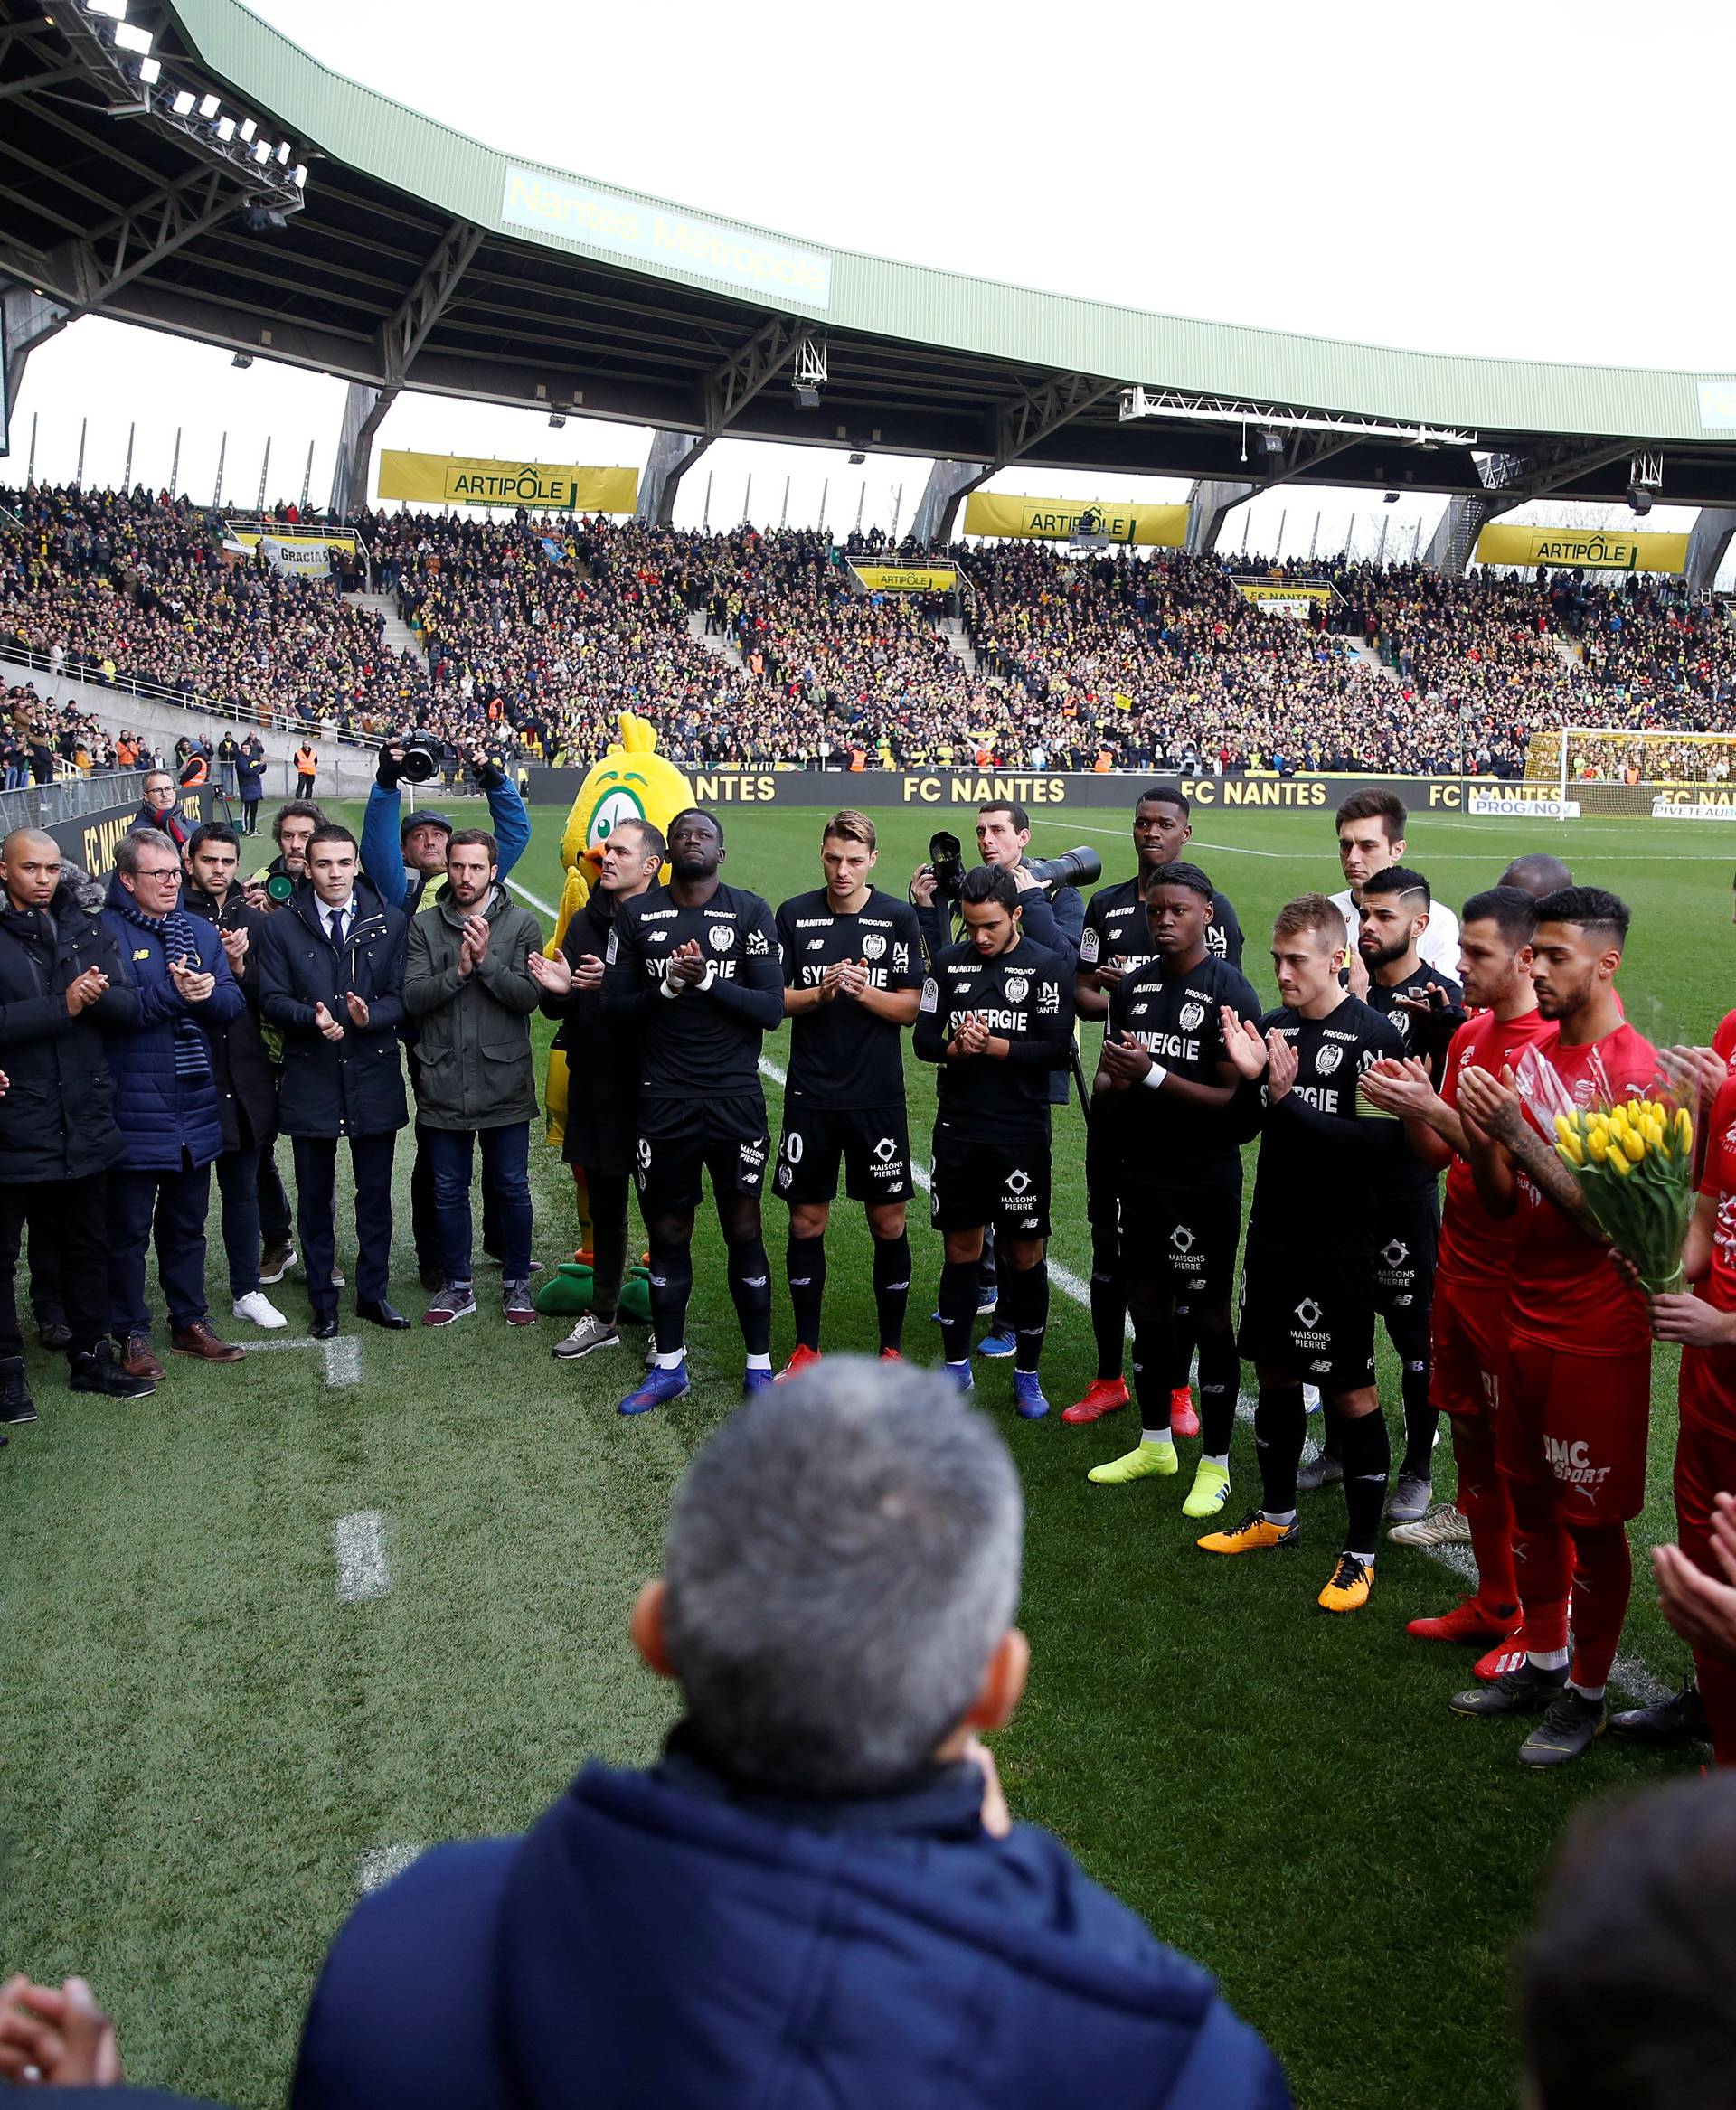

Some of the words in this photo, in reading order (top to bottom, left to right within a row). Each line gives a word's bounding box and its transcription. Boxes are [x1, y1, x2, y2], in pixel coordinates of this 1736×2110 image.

[454, 467, 563, 499] ARTIPÔLE
[1537, 535, 1626, 561] ARTIPÔLE
[281, 547, 328, 563] GRACIAS
[904, 777, 941, 802] FC
[951, 778, 1065, 803] NANTES
[1223, 781, 1326, 805] NANTES
[1429, 785, 1461, 807] FC
[84, 825, 100, 877] FC
[640, 909, 678, 921] MANITOU
[796, 918, 835, 928] MANITOU
[948, 965, 983, 974] MANITOU
[740, 1152, 762, 1167] PIERRE
[869, 1160, 903, 1172] MAISONS
[873, 1169, 901, 1178] PIERRE
[1000, 1195, 1037, 1203] MAISONS
[1005, 1202, 1033, 1210] PIERRE
[1168, 1254, 1205, 1263] MAISONS
[1174, 1262, 1201, 1270] PIERRE
[1378, 1276, 1410, 1286] PIERRE
[1290, 1330, 1332, 1342] MAISONS
[1295, 1339, 1327, 1350] PIERRE
[1552, 1460, 1611, 1484] SPORT
